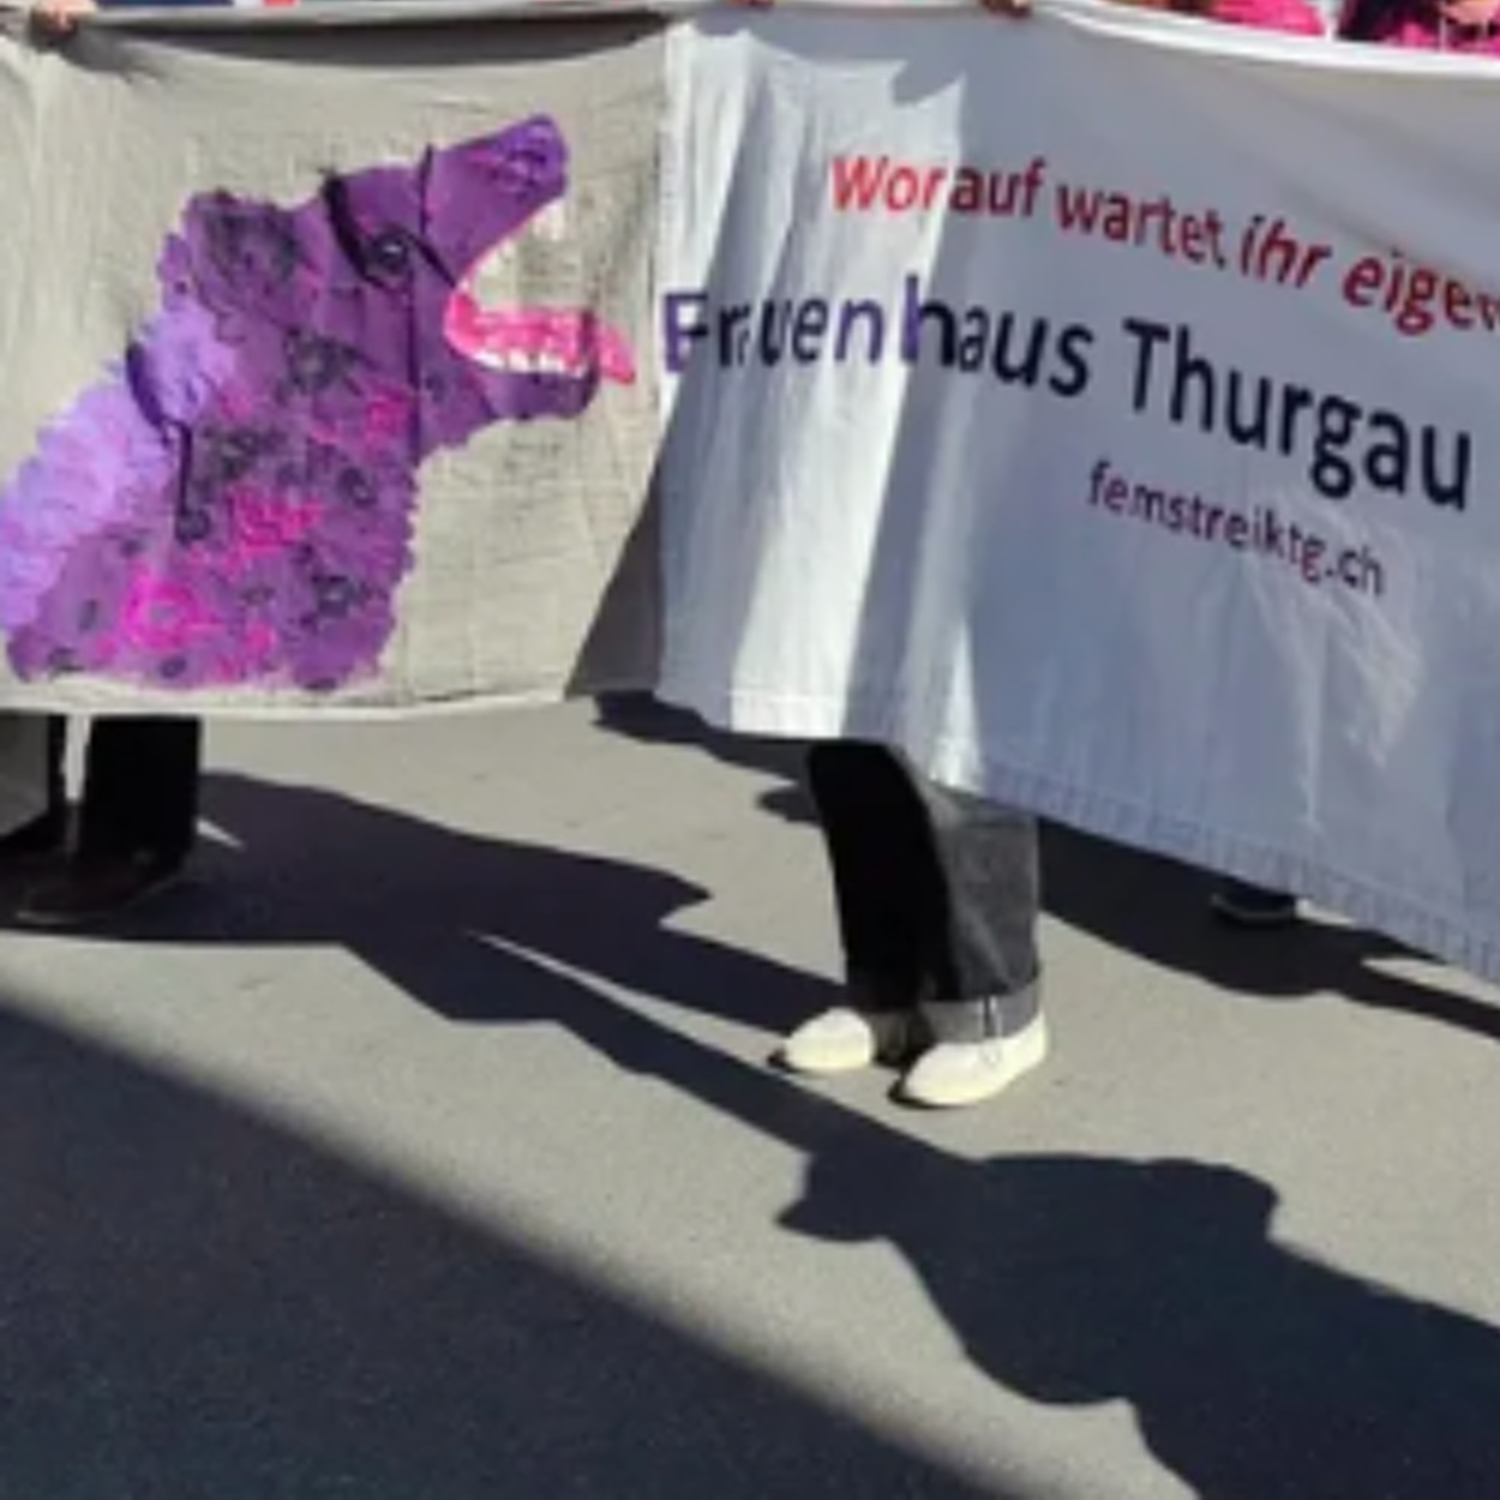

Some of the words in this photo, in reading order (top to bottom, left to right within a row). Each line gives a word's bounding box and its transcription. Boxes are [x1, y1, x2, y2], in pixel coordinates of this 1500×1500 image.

[832, 153, 1044, 218] Worauf
[1057, 183, 1224, 270] wartet
[1238, 214, 1331, 290] ihr
[1123, 318, 1472, 511] Thurgau
[1088, 459, 1383, 596] femstreiktg.ch
